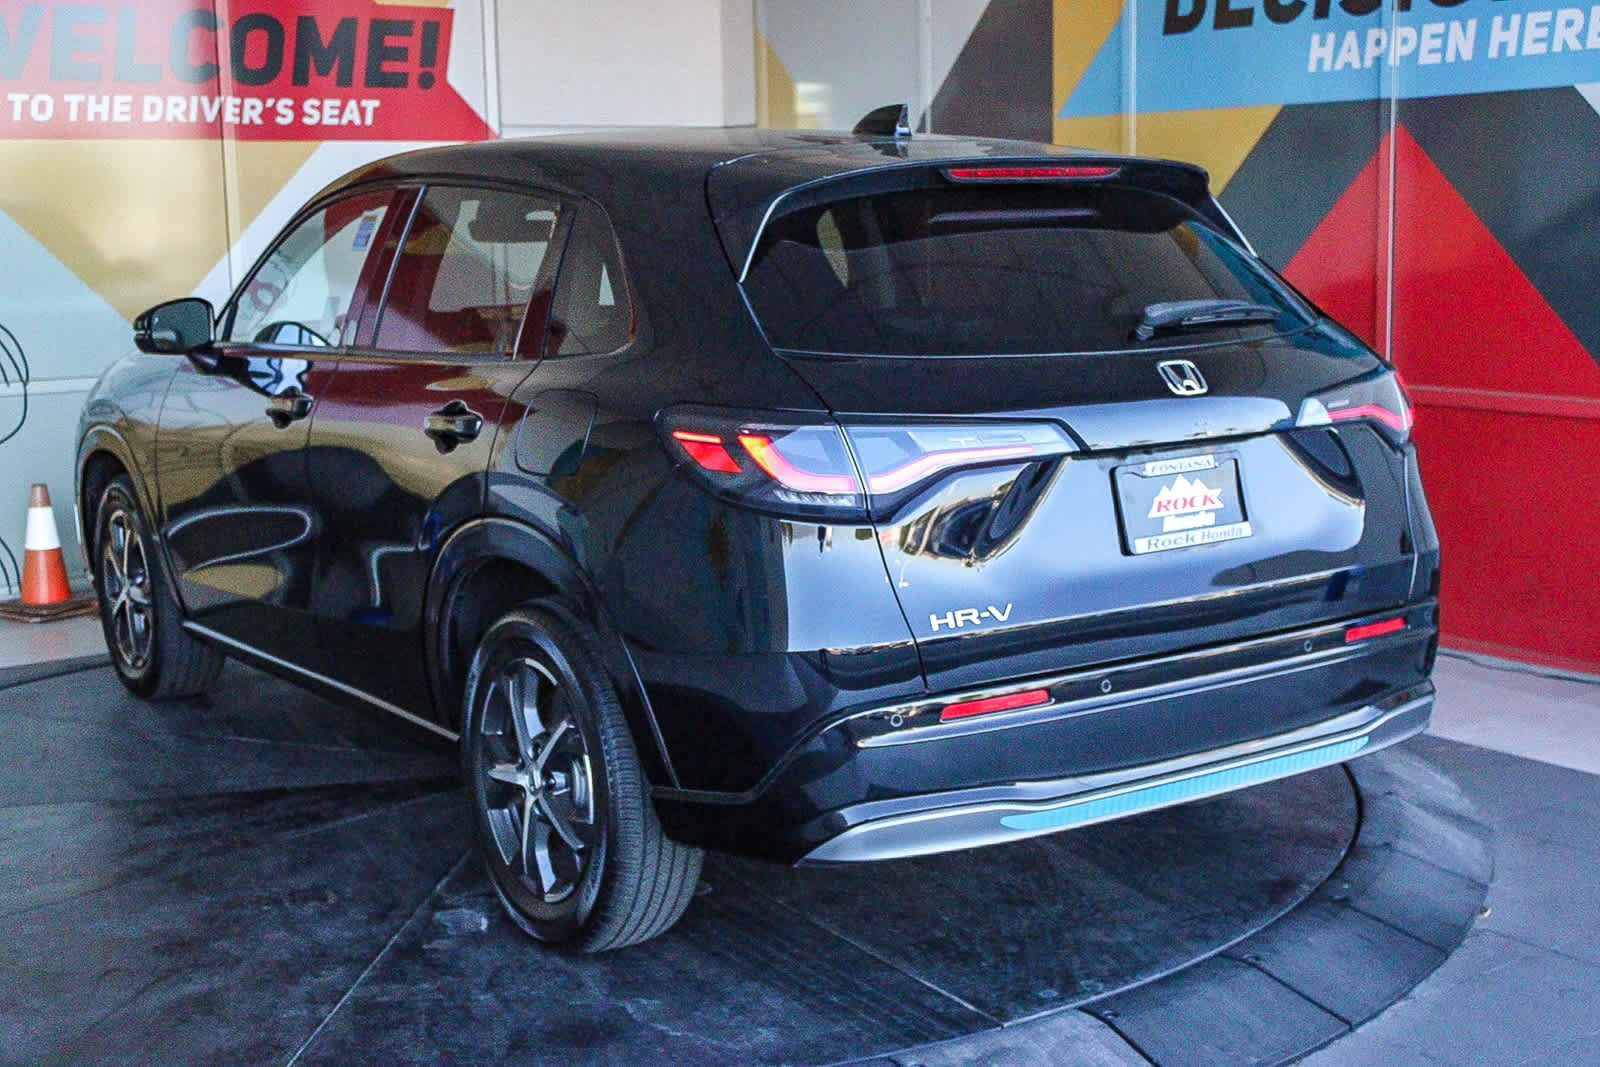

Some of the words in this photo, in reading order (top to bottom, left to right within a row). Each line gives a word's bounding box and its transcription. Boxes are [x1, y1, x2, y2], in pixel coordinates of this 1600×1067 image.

[1307, 18, 1478, 73] HAPPEN
[7, 92, 55, 122] TO
[63, 93, 133, 123] THE
[141, 95, 295, 126] DRIVER'S
[302, 98, 381, 127] SEAT
[1156, 493, 1216, 513] ROCK
[1147, 530, 1196, 551] Rock
[1201, 526, 1244, 541] Honda
[929, 603, 1013, 632] HR-V
